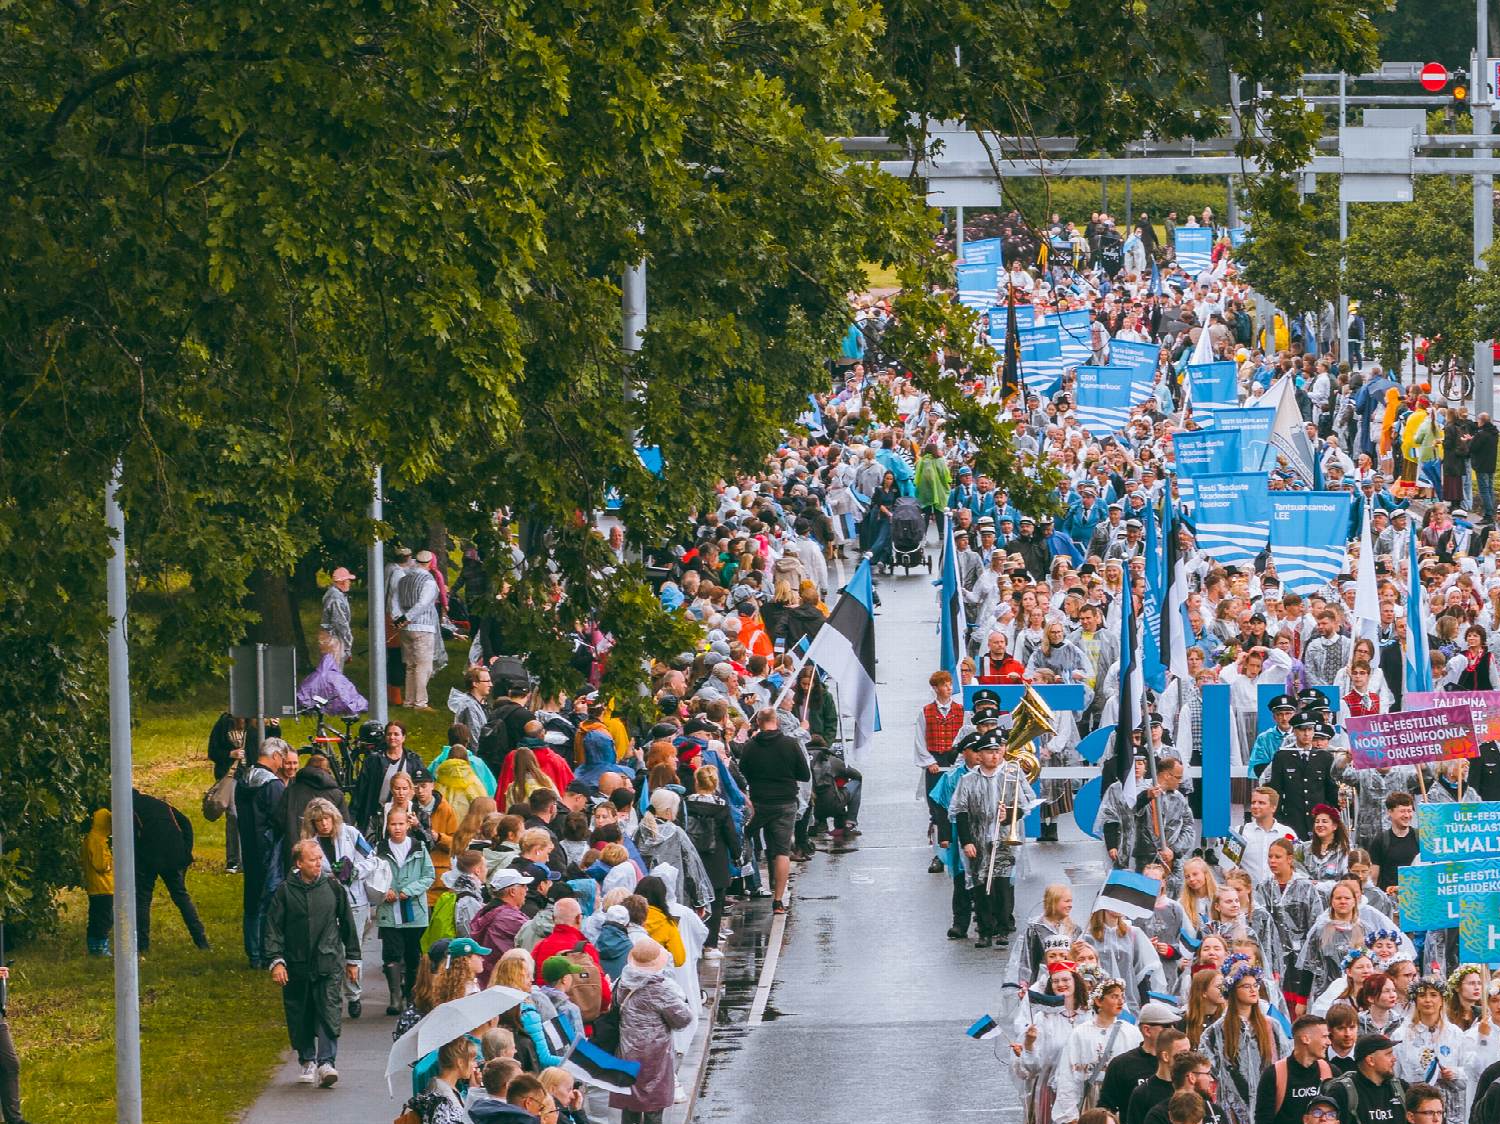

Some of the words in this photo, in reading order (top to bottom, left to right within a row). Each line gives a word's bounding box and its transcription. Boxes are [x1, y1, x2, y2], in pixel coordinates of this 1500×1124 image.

[1274, 512, 1290, 520] LEE
[1433, 697, 1487, 708] TALLINNA
[1370, 714, 1449, 733] ÜLE-EESTILINE
[1354, 734, 1398, 750] NOORTE
[1400, 726, 1470, 744] SÜMFOONIA-
[1387, 743, 1443, 760] ORKESTER
[1368, 1108, 1394, 1121] TÜRI
